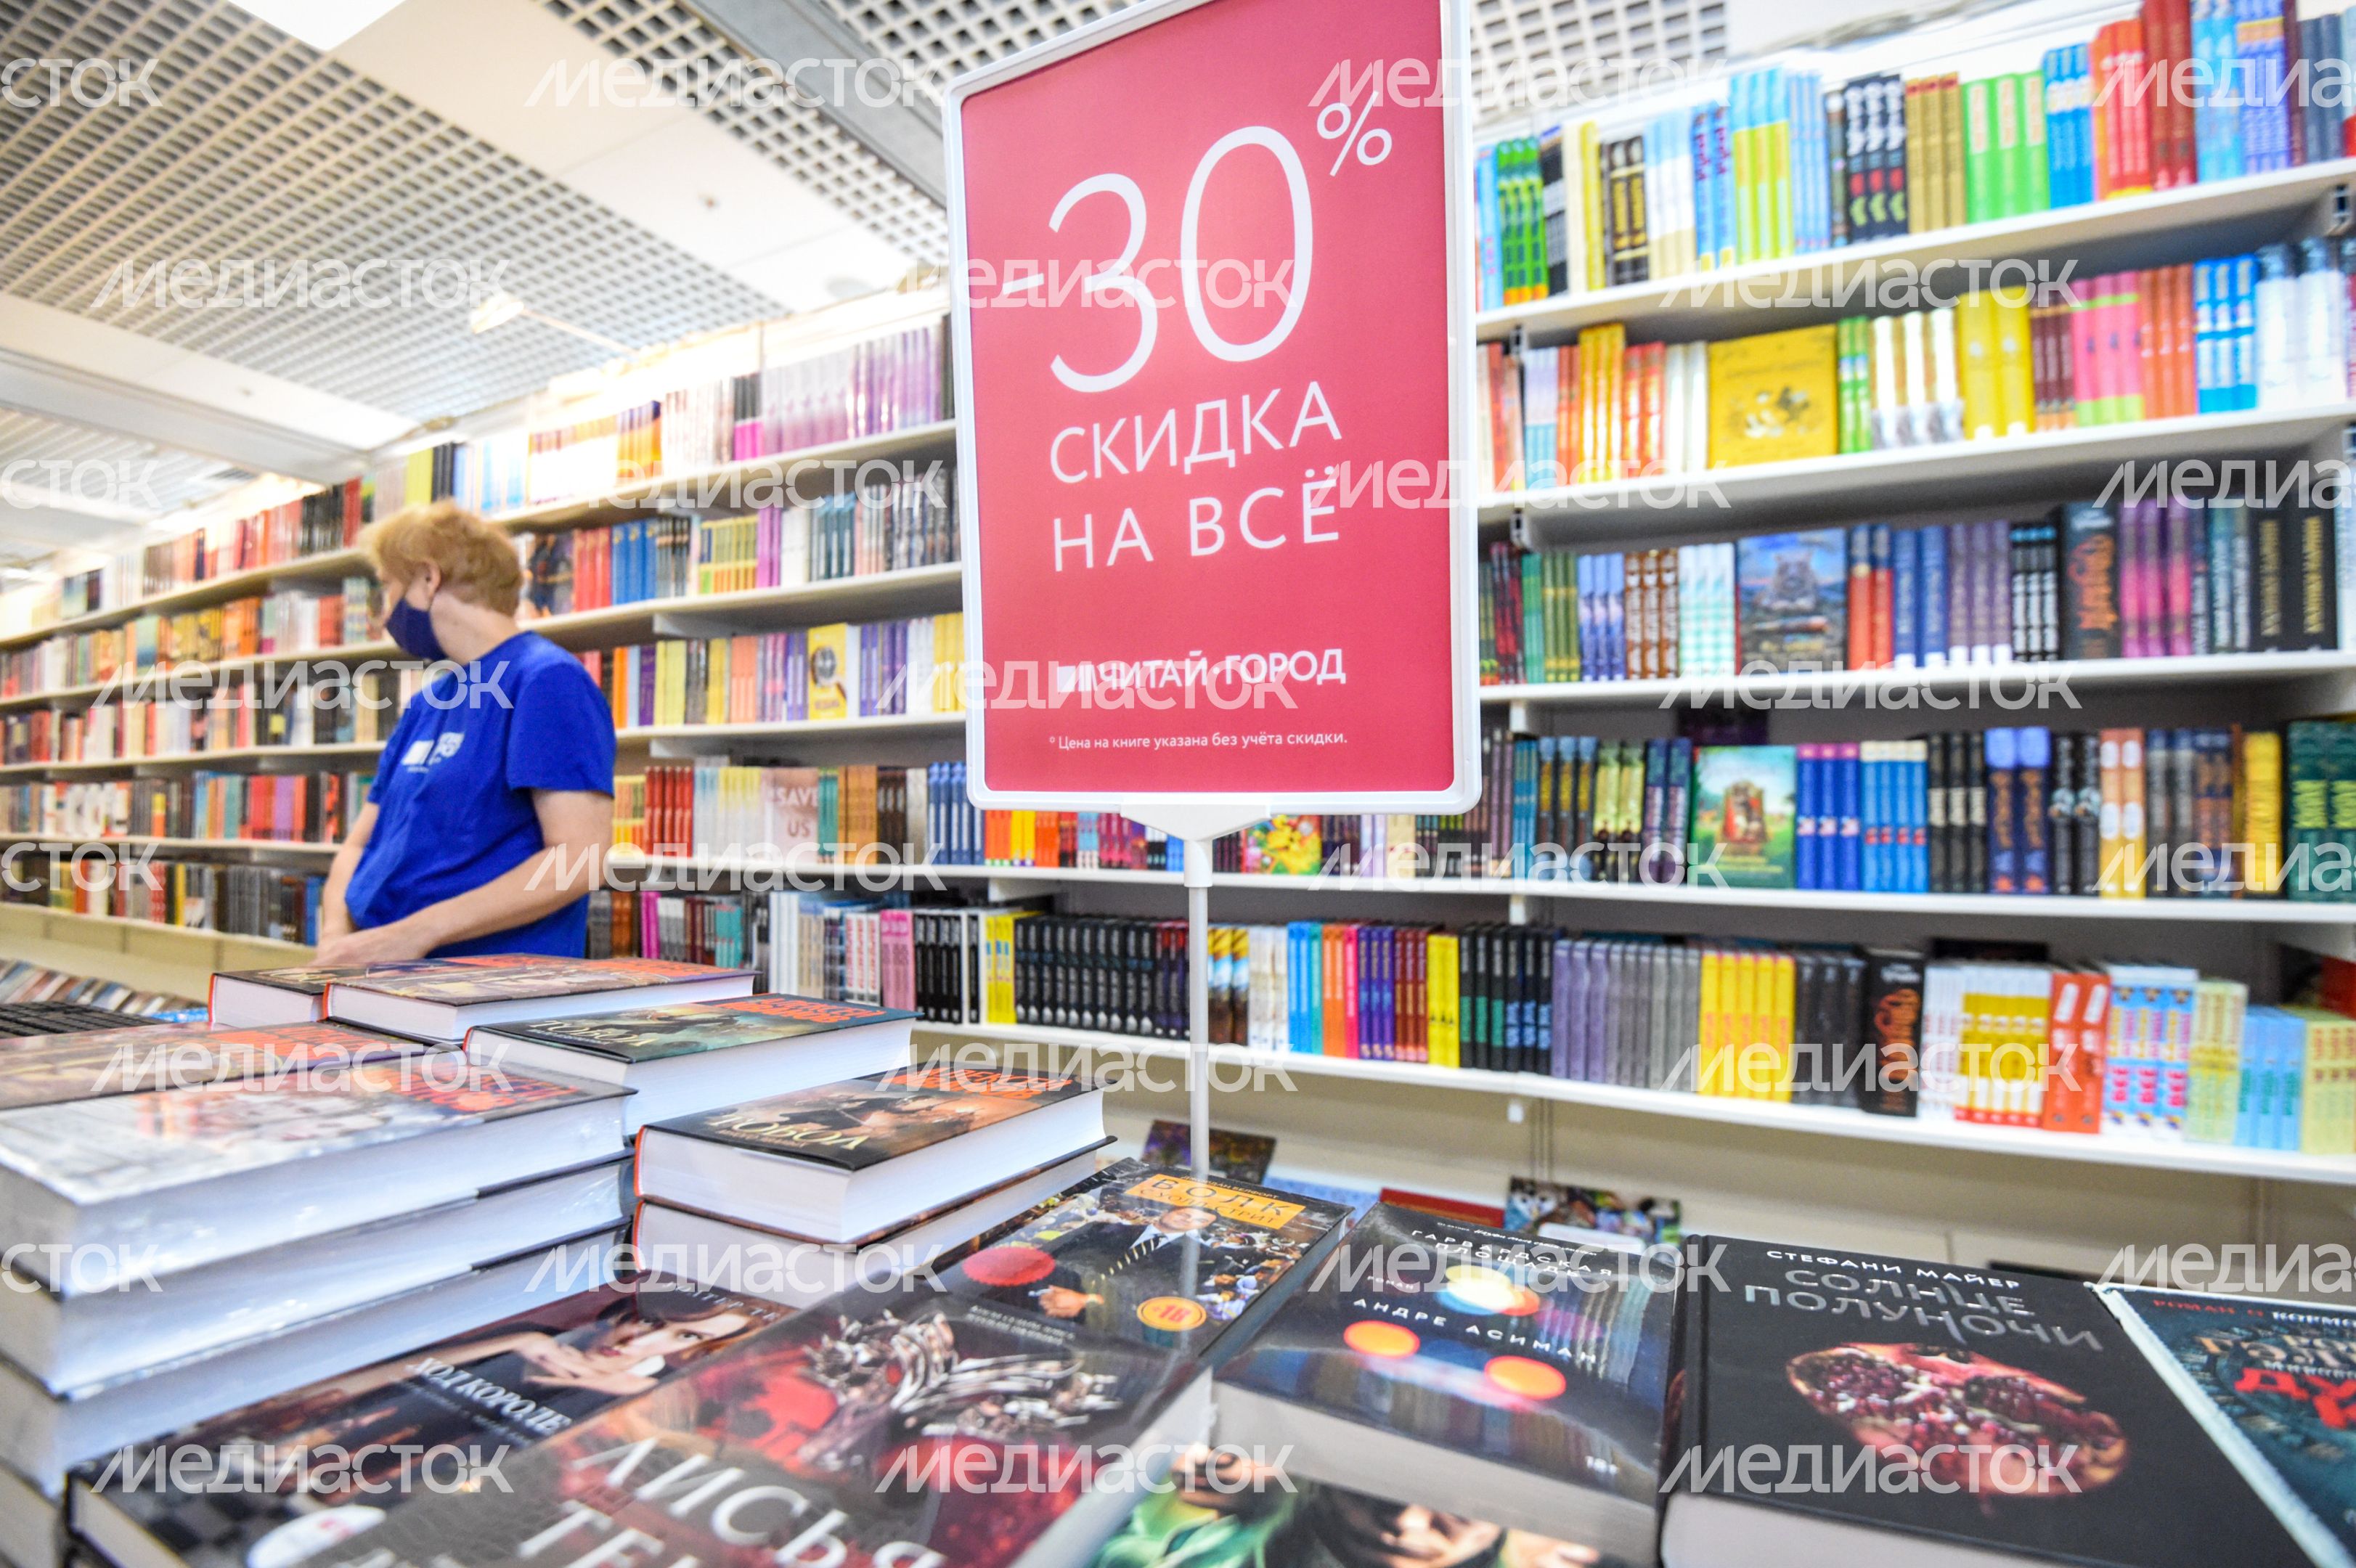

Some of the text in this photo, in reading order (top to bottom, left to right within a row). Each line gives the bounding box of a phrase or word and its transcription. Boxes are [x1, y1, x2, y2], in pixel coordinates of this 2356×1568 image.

[1050, 381, 1342, 483] СКИДКА
[1053, 466, 1340, 572] НА ВСЁ
[1058, 732, 1348, 751] Цена на книге указана без учёта скидки.
[707, 1114, 870, 1151] ТОБОЛ
[1151, 1178, 1290, 1217] ВОЛК
[1411, 1230, 1612, 1276] ГАРВАРДСКАЯ
[1766, 1250, 2020, 1289] СТЕФАНИ МАЙЕР
[1785, 1269, 2035, 1316] СОЛНЦЕ
[1353, 1297, 1597, 1363] АНДРЕ АСИМАН
[1745, 1284, 2104, 1352] ПОЛУНОЧИ
[404, 1357, 473, 1390] ХОД
